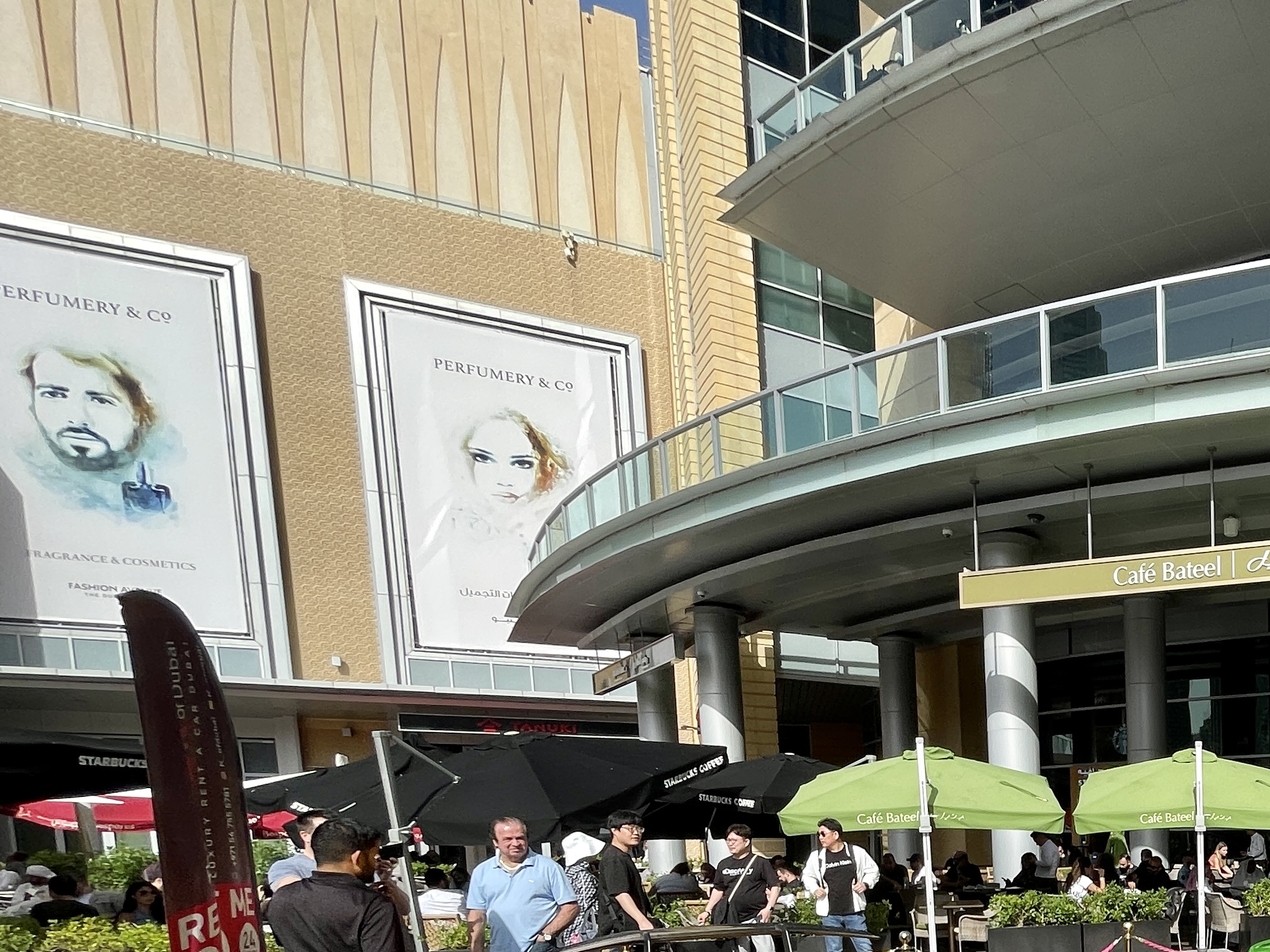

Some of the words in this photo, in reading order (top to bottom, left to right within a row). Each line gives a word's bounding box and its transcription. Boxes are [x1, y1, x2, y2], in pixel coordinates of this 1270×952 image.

[0, 284, 121, 316] ERFUMERY
[126, 306, 142, 320] &
[433, 357, 536, 387] PERFUMERY
[538, 377, 551, 390] &
[27, 549, 108, 564] FRAGRANCE
[110, 556, 121, 566] &
[122, 556, 197, 571] COSMETICS
[1112, 562, 1157, 586] Café
[1162, 555, 1221, 581] Bateel
[68, 582, 118, 593] FASHION
[511, 722, 577, 734] TANUKI
[79, 755, 147, 768] STARBUCKS
[664, 767, 698, 789] STARBUCKS
[699, 793, 732, 805] STARBUCKS
[857, 812, 883, 825] Café
[886, 810, 919, 823] Bateel
[1140, 812, 1163, 824] Café
[1165, 811, 1195, 822] Bateel
[229, 887, 256, 919] ME
[243, 930, 257, 949] 24
